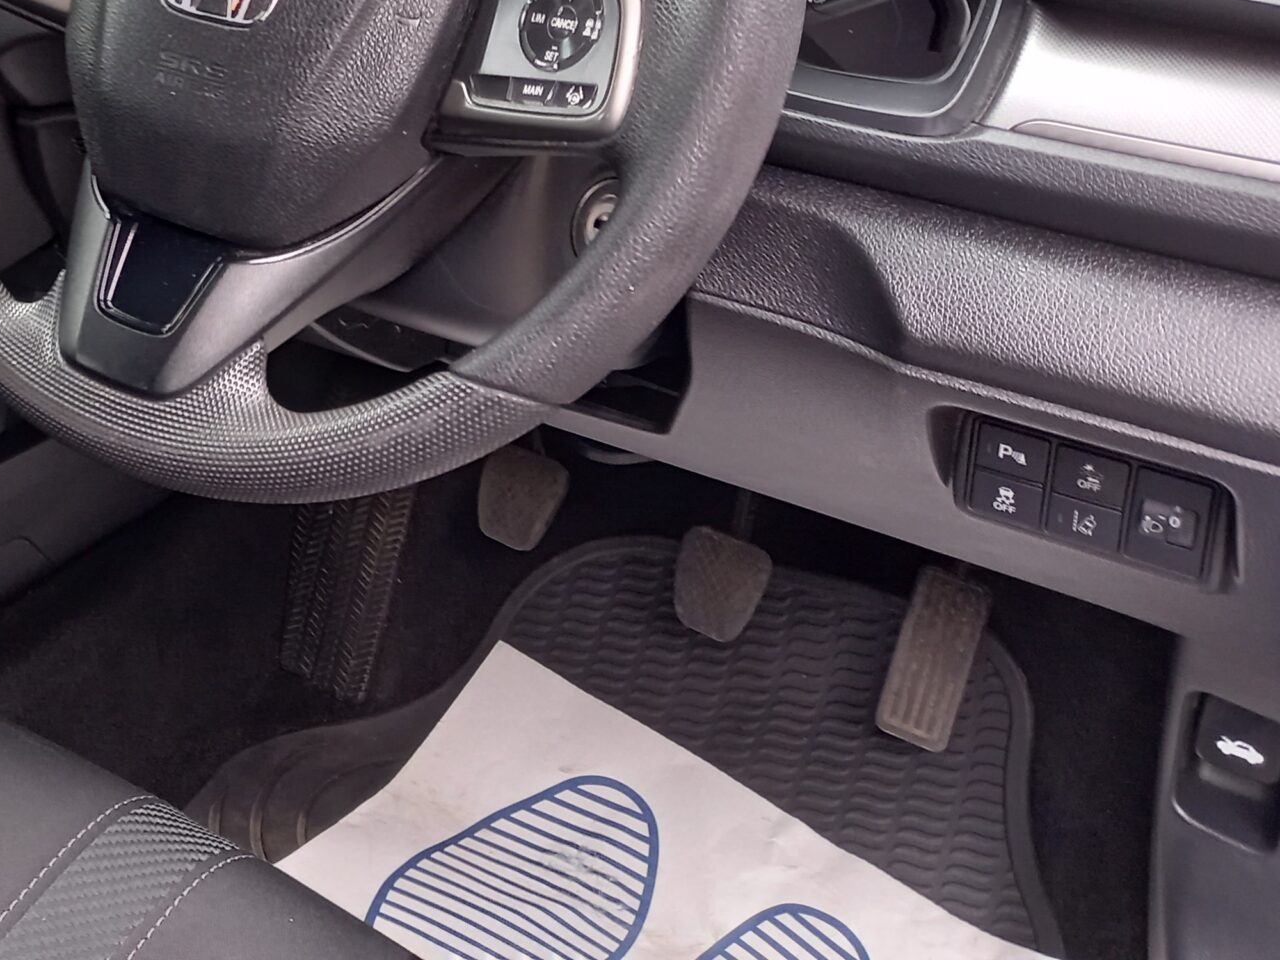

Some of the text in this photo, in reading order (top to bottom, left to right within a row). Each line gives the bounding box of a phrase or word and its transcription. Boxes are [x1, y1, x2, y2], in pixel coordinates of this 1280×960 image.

[531, 11, 546, 24] LIM
[544, 50, 560, 62] SET
[522, 83, 544, 97] MAIN
[1076, 478, 1101, 493] OFF
[992, 501, 1017, 514] OFF
